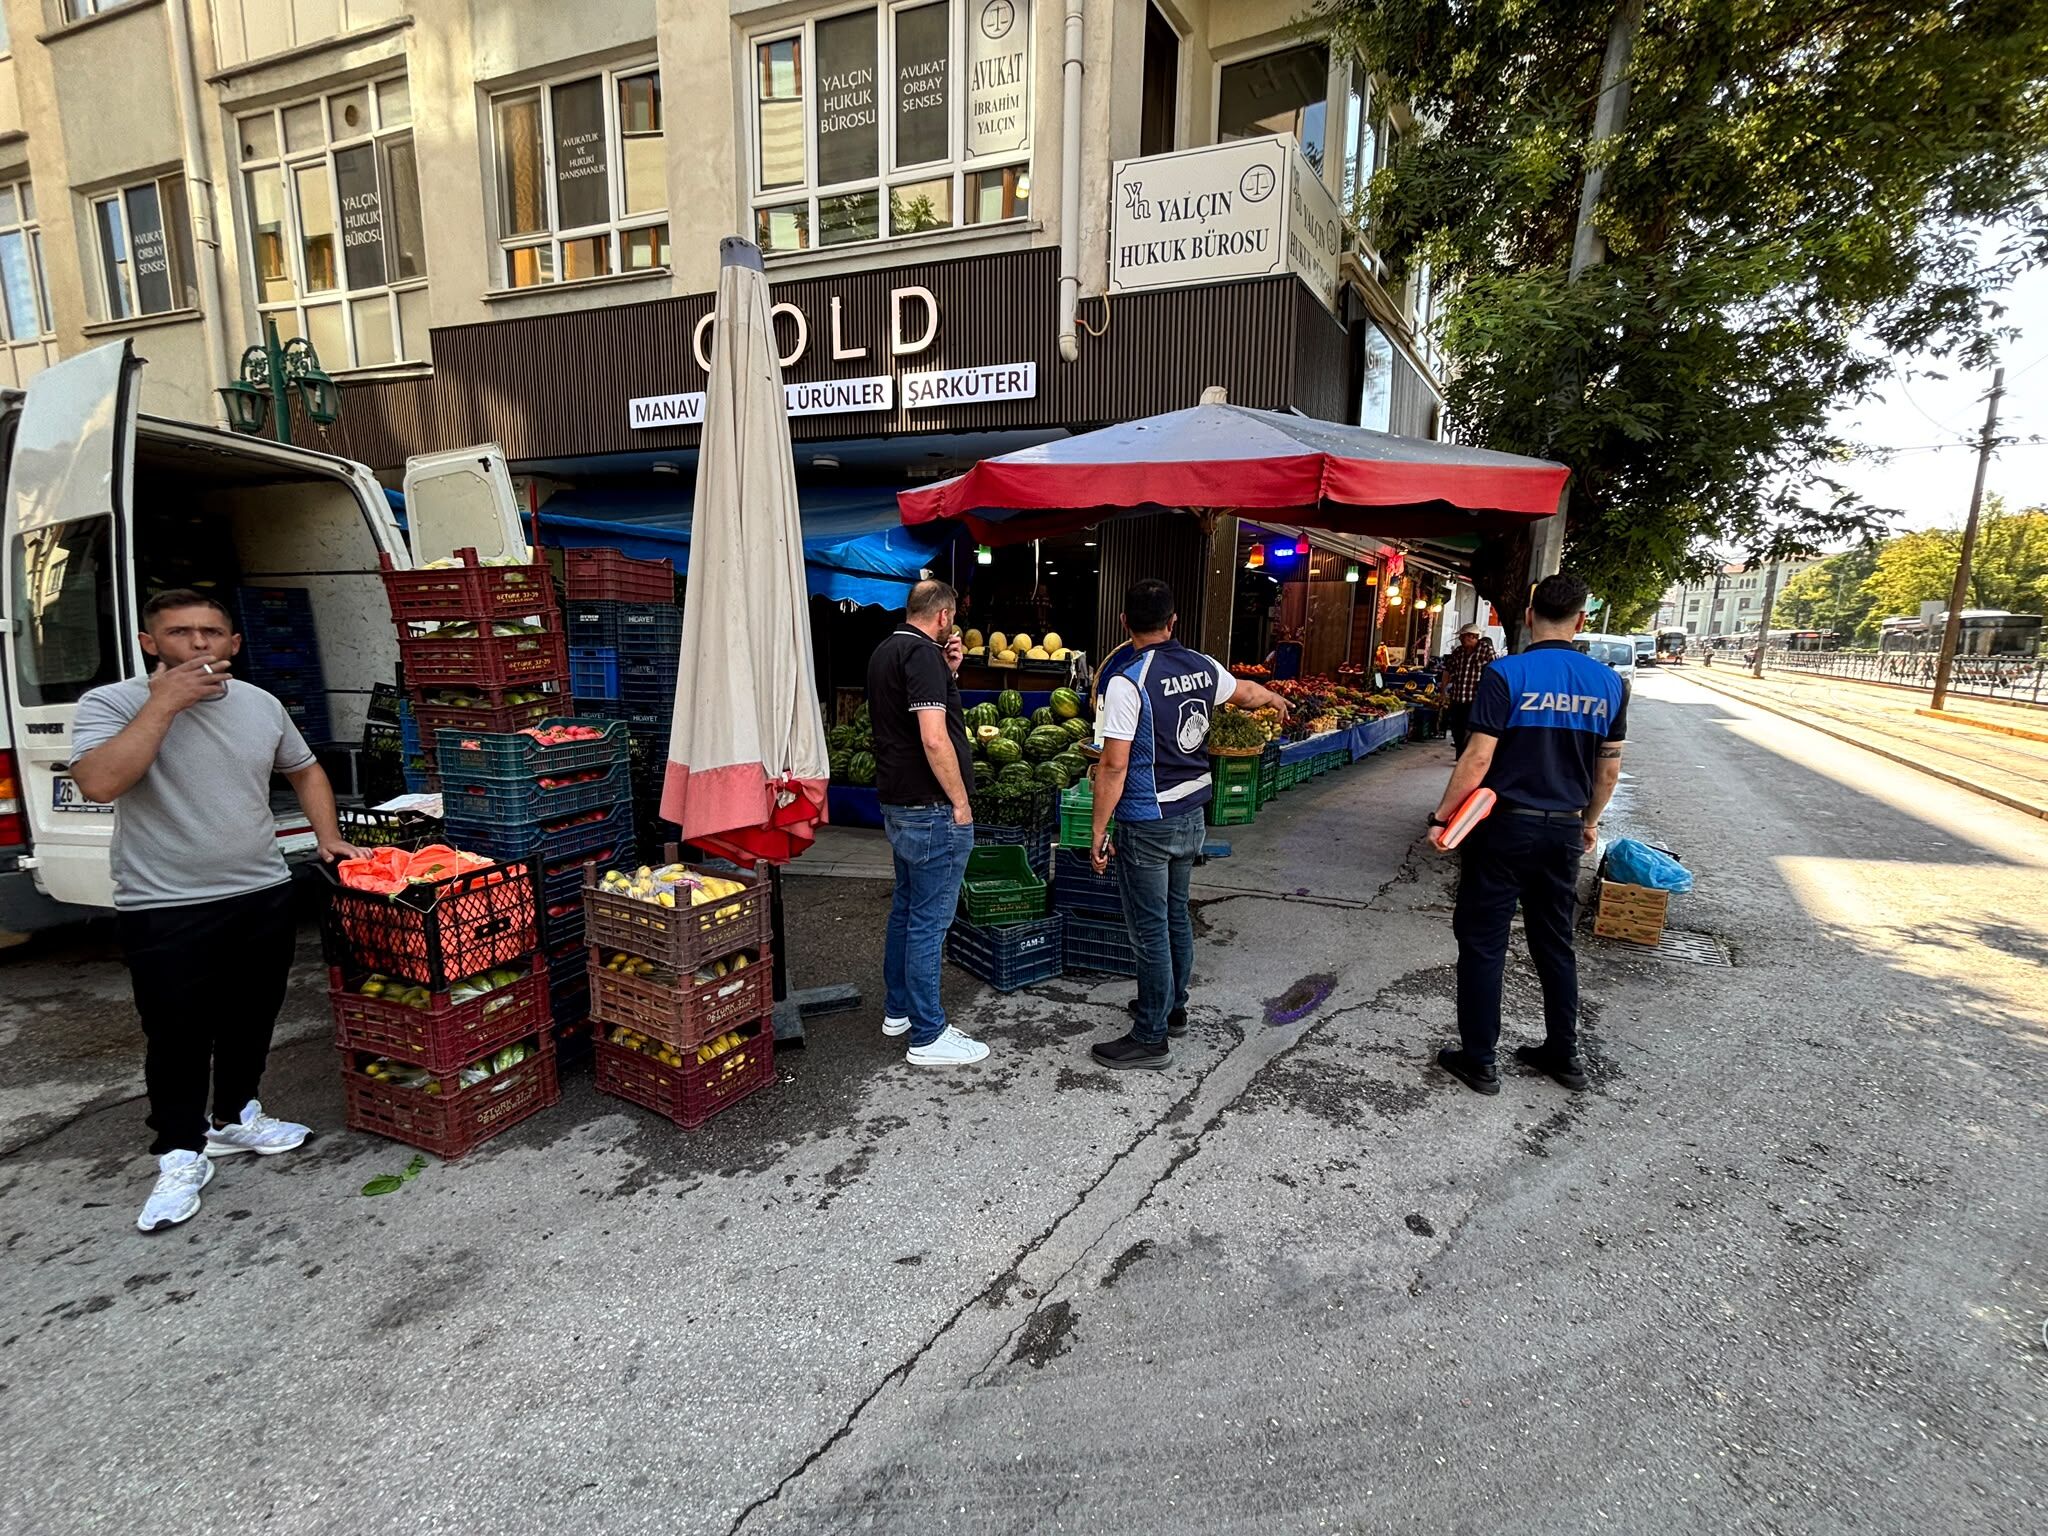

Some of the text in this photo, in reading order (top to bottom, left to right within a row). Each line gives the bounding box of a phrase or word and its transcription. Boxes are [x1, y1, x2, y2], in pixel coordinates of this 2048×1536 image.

[822, 67, 873, 92] YALÇIN
[900, 59, 947, 80] AVUKAT
[971, 52, 1024, 92] AVUKAT
[903, 76, 943, 95] ORBAY
[823, 89, 873, 113] HUKUK
[902, 92, 943, 113] ŞENSES
[974, 93, 1020, 117] İBRAHİM
[821, 109, 876, 134] BÜROSU
[977, 115, 1016, 135] YALÇIN
[562, 132, 599, 148] AVUKATLIK
[576, 146, 586, 156] VE
[342, 191, 379, 211] YALÇIN
[1157, 190, 1233, 224] YALÇIN
[345, 208, 381, 229] HUKUK
[345, 228, 383, 247] BÜROSU
[1119, 228, 1270, 269] HUKUK BÜROSU
[798, 383, 885, 409] ÜRÜNLER
[907, 364, 1030, 406] ŞARKÜTERİ
[635, 398, 701, 424] MANAV
[1160, 670, 1213, 697] ZABITA
[1520, 692, 1608, 719] ZABITA
[60, 781, 73, 802] 26
